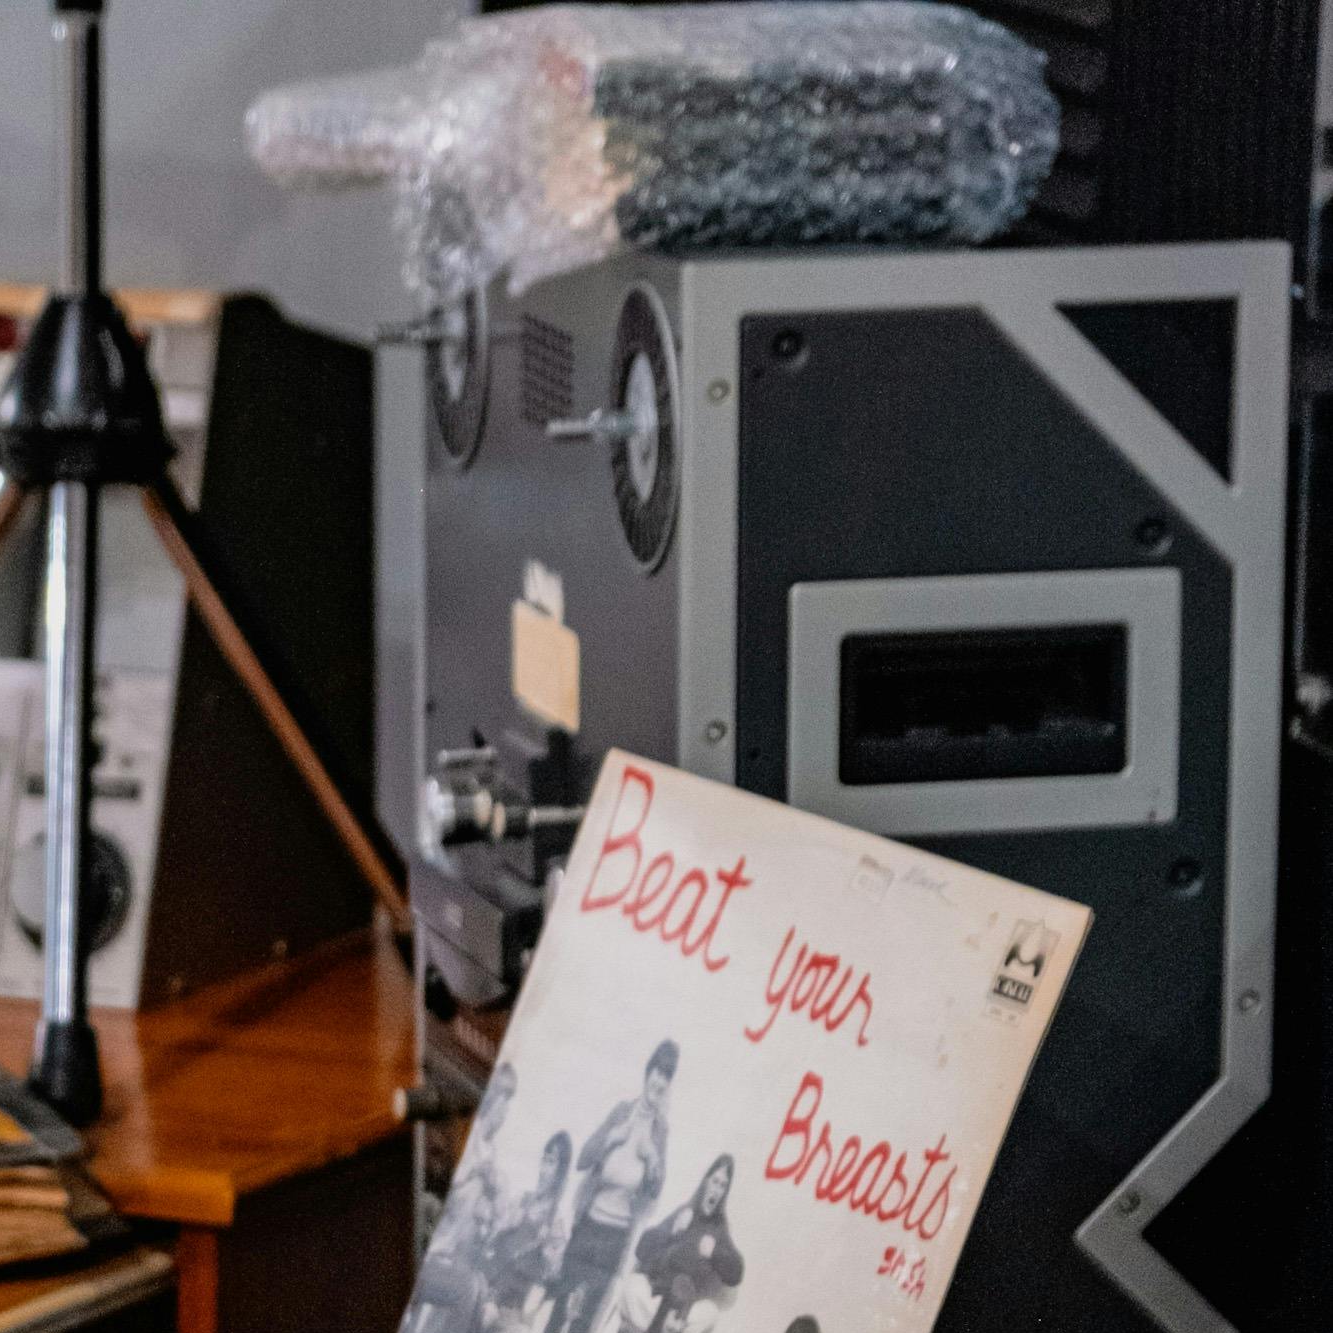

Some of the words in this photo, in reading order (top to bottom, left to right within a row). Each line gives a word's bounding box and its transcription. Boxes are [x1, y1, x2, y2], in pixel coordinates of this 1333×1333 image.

[579, 765, 752, 973] Beat
[744, 925, 874, 1047] your
[765, 1070, 959, 1241] Breasts
